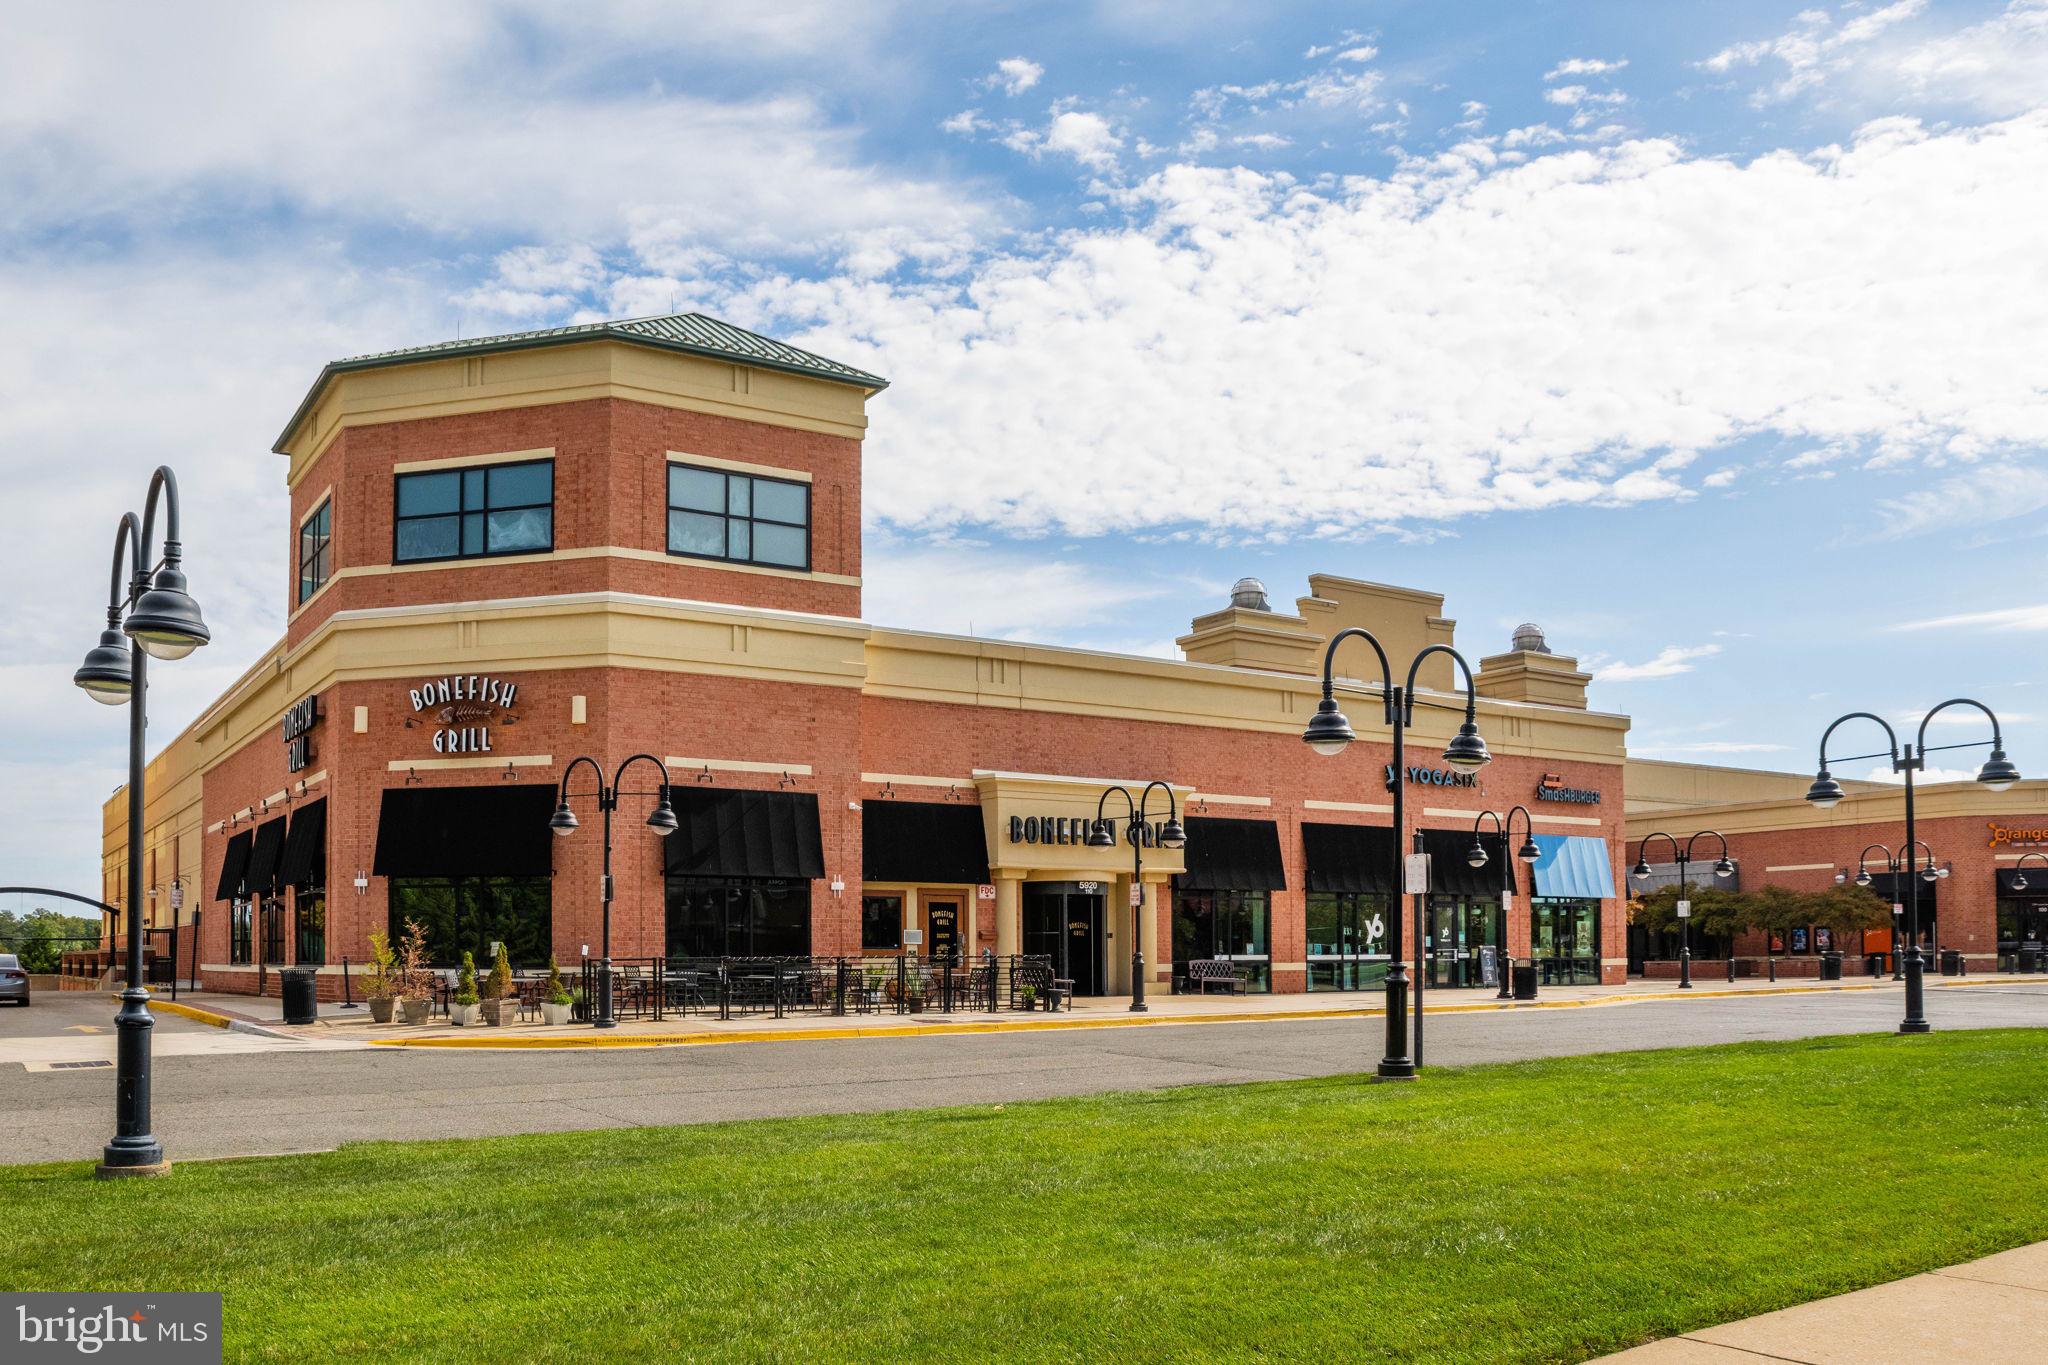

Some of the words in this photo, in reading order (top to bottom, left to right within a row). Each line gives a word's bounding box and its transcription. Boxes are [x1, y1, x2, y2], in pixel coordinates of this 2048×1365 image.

[410, 676, 516, 712] BONEFISH
[433, 727, 491, 753] GRILL
[1407, 766, 1477, 788] YOGASIX
[1010, 815, 1117, 847] BONEFIH
[1126, 821, 1185, 849] GRI
[980, 886, 994, 894] FDC
